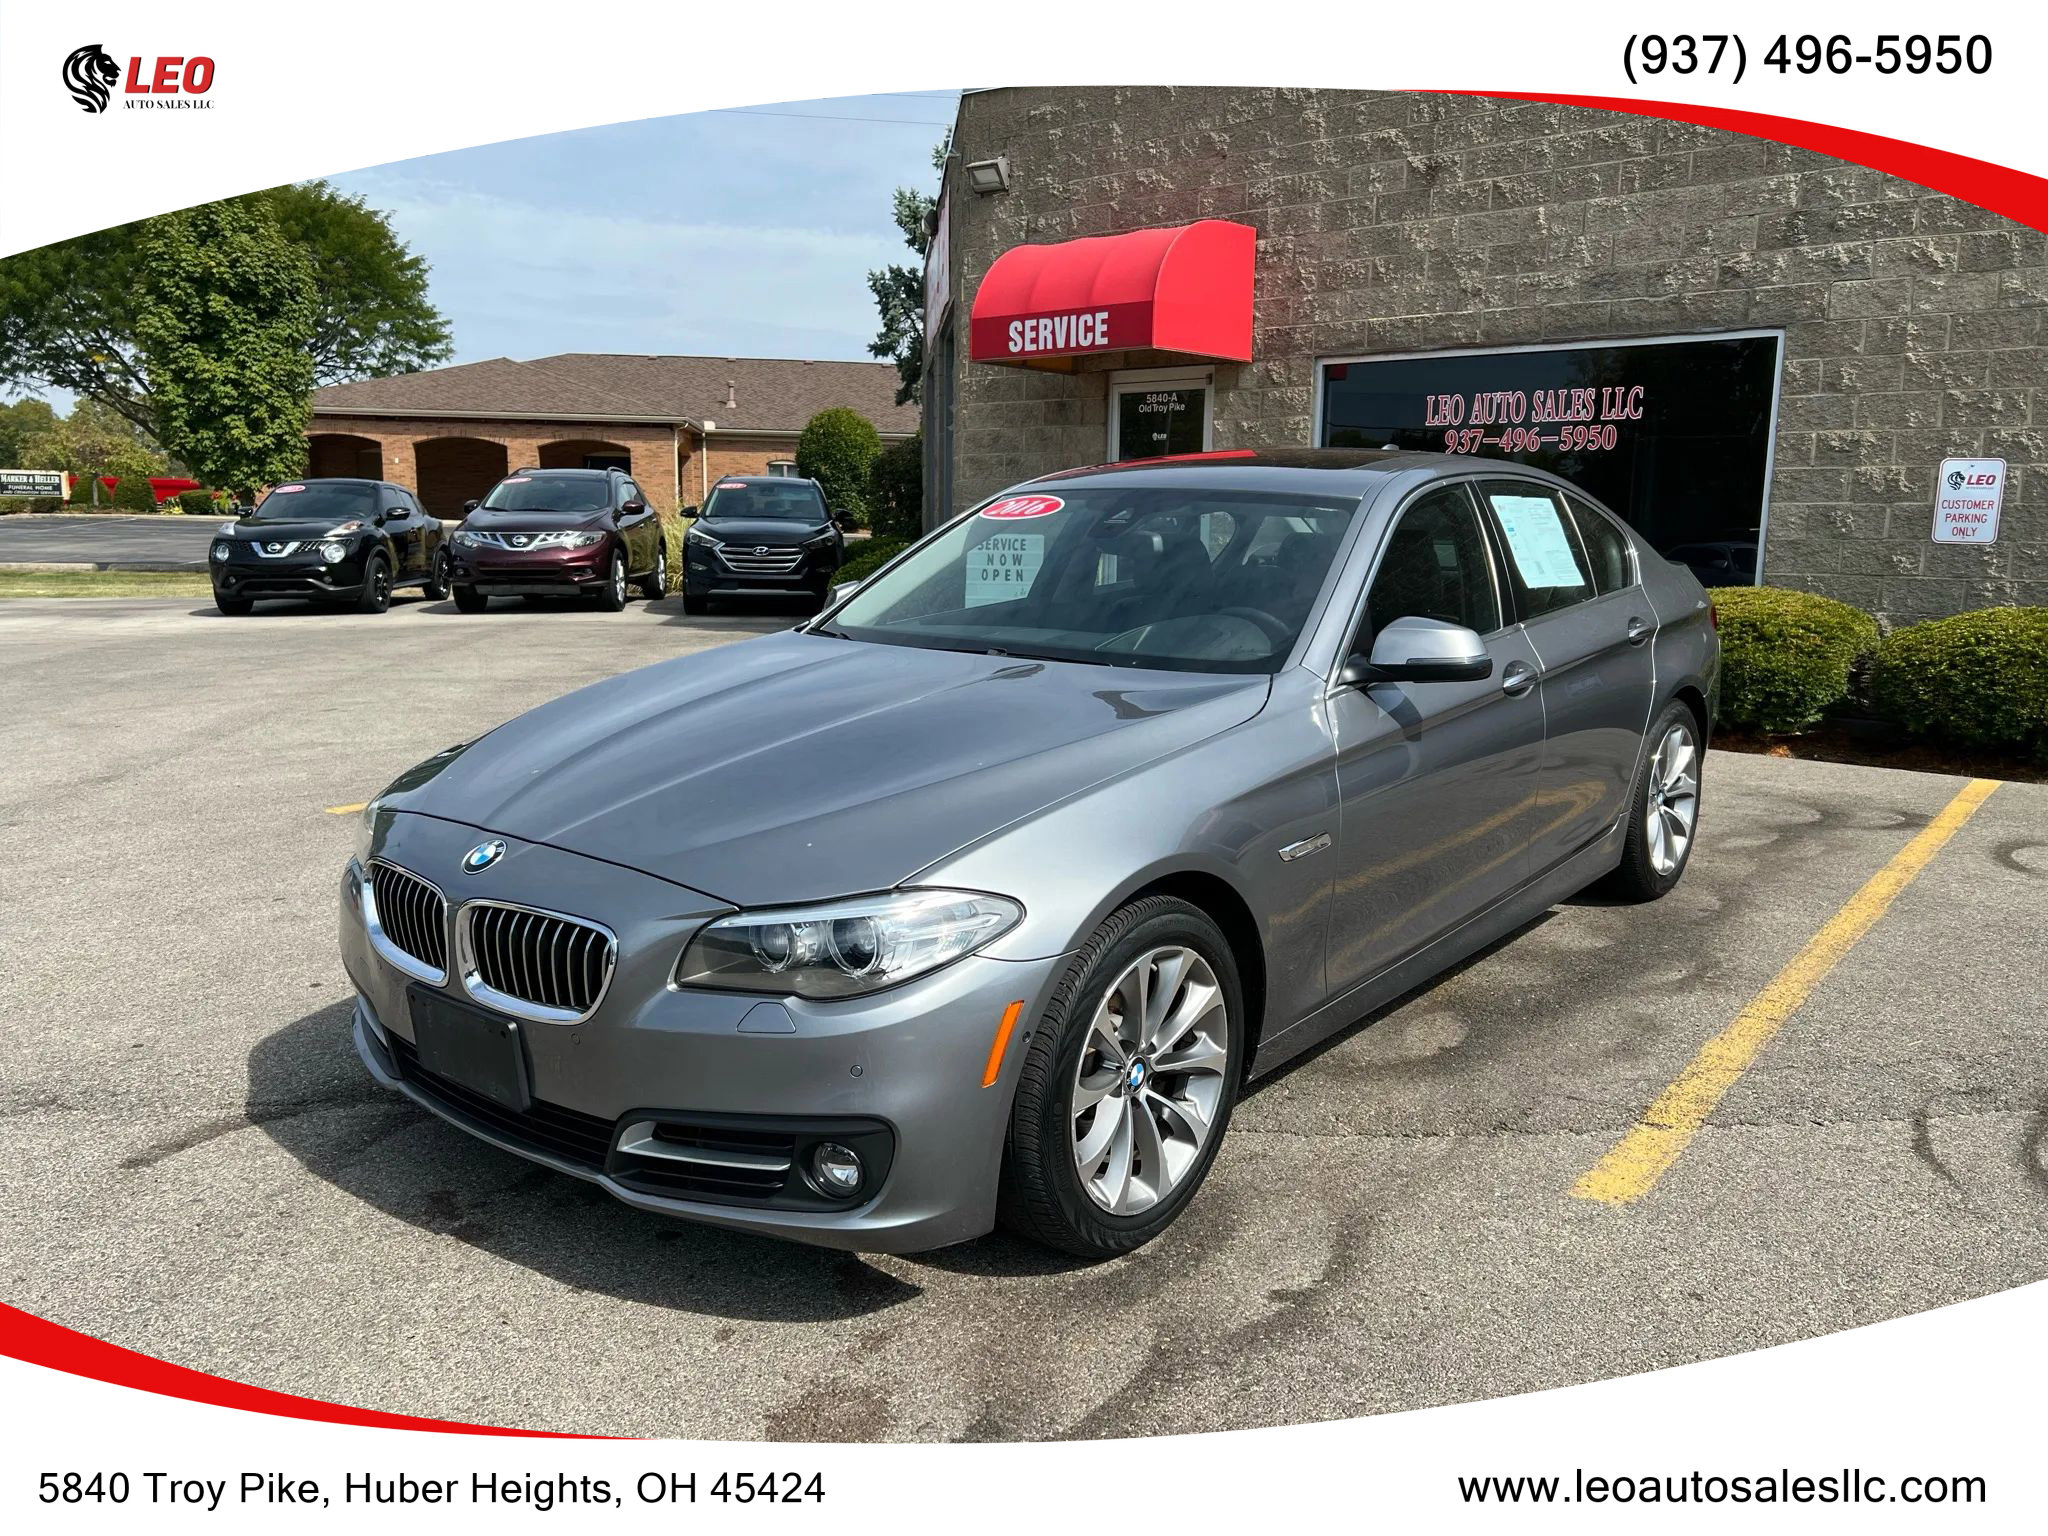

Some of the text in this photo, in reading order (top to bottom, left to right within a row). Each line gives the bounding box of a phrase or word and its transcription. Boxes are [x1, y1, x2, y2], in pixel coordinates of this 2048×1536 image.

[1008, 311, 1109, 353] SERVICE
[1146, 393, 1178, 404] 5840-A
[1138, 402, 1186, 414] Old Troy Pike
[1425, 385, 1644, 426] LEO AUTO SALES LLC
[1444, 424, 1617, 455] 937-496-5950
[1966, 474, 1997, 486] LEO
[1941, 499, 1995, 510] CUSTOMER
[1944, 513, 1988, 524] PARKING
[1951, 526, 1978, 537] ONLY
[977, 538, 1027, 551] SERVICE
[987, 553, 1023, 567] NOW
[981, 568, 1024, 582] OPEN
